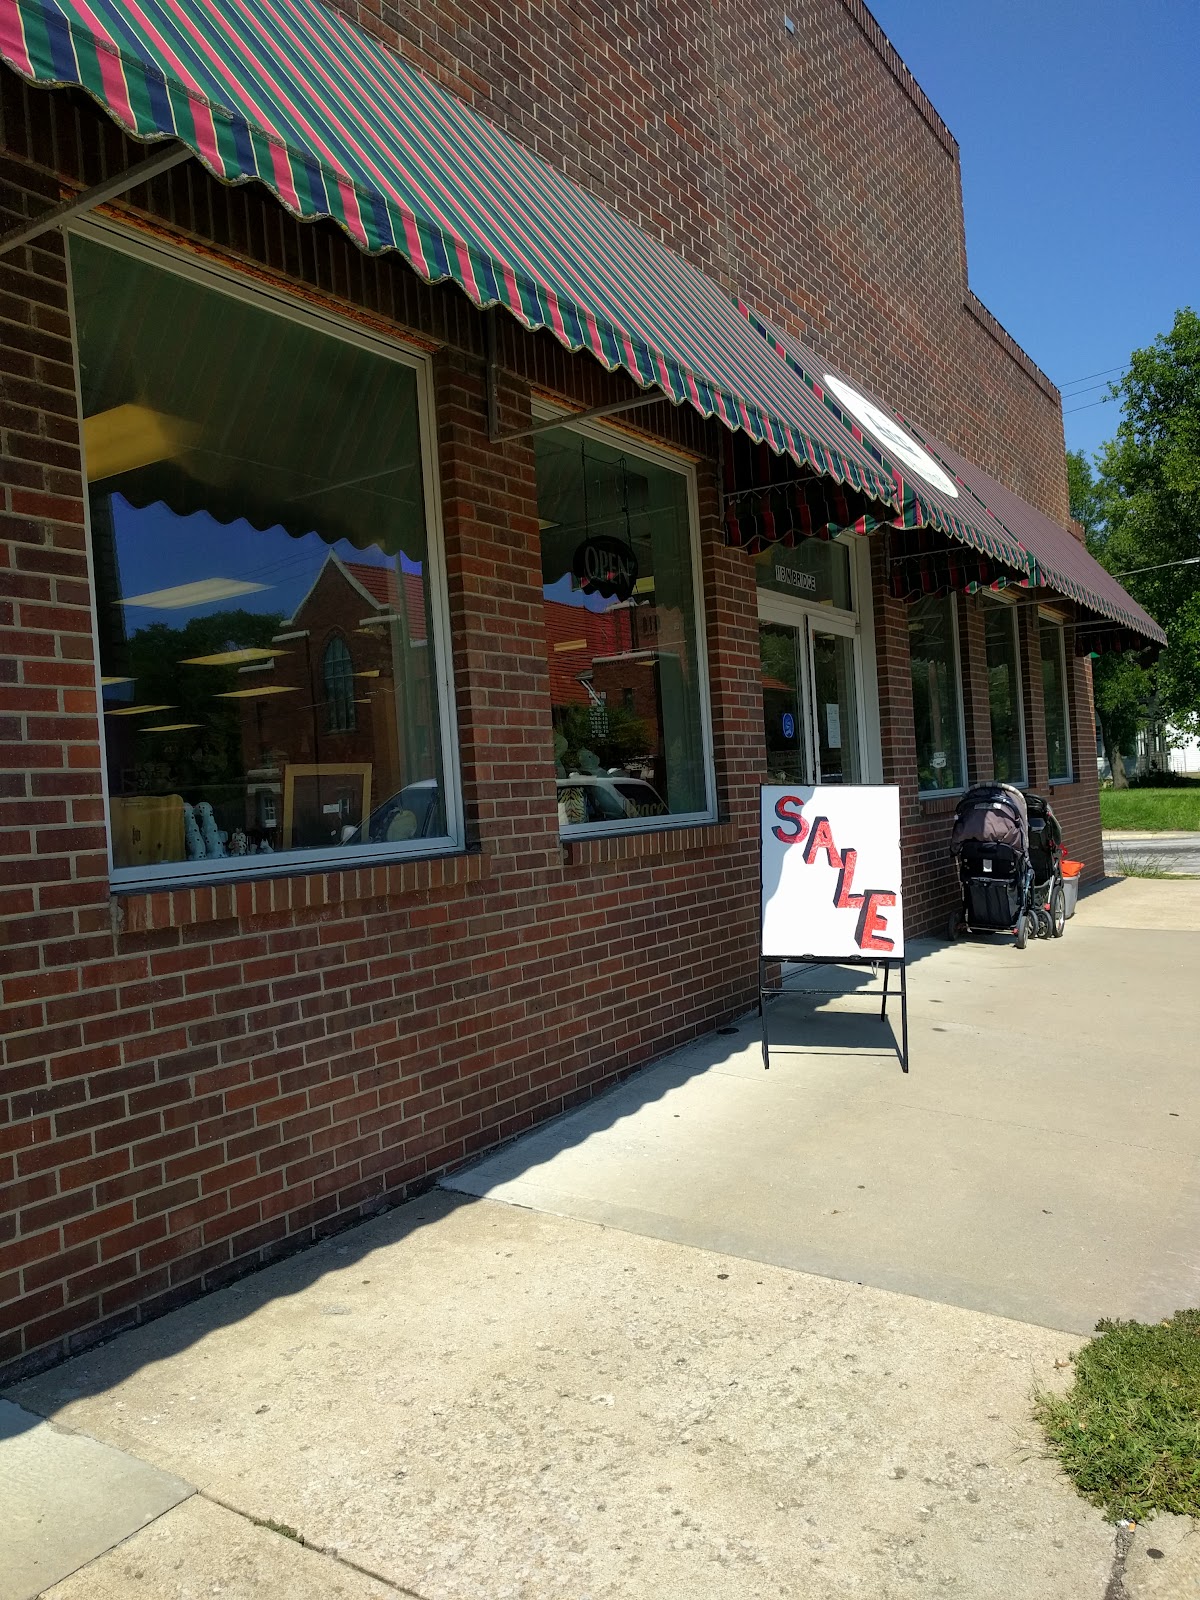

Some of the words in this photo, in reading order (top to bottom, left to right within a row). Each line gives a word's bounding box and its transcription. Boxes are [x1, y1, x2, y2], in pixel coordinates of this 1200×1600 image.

[584, 545, 630, 588] OPEN
[793, 571, 816, 591] BRIDGE
[771, 795, 897, 952] SALE
